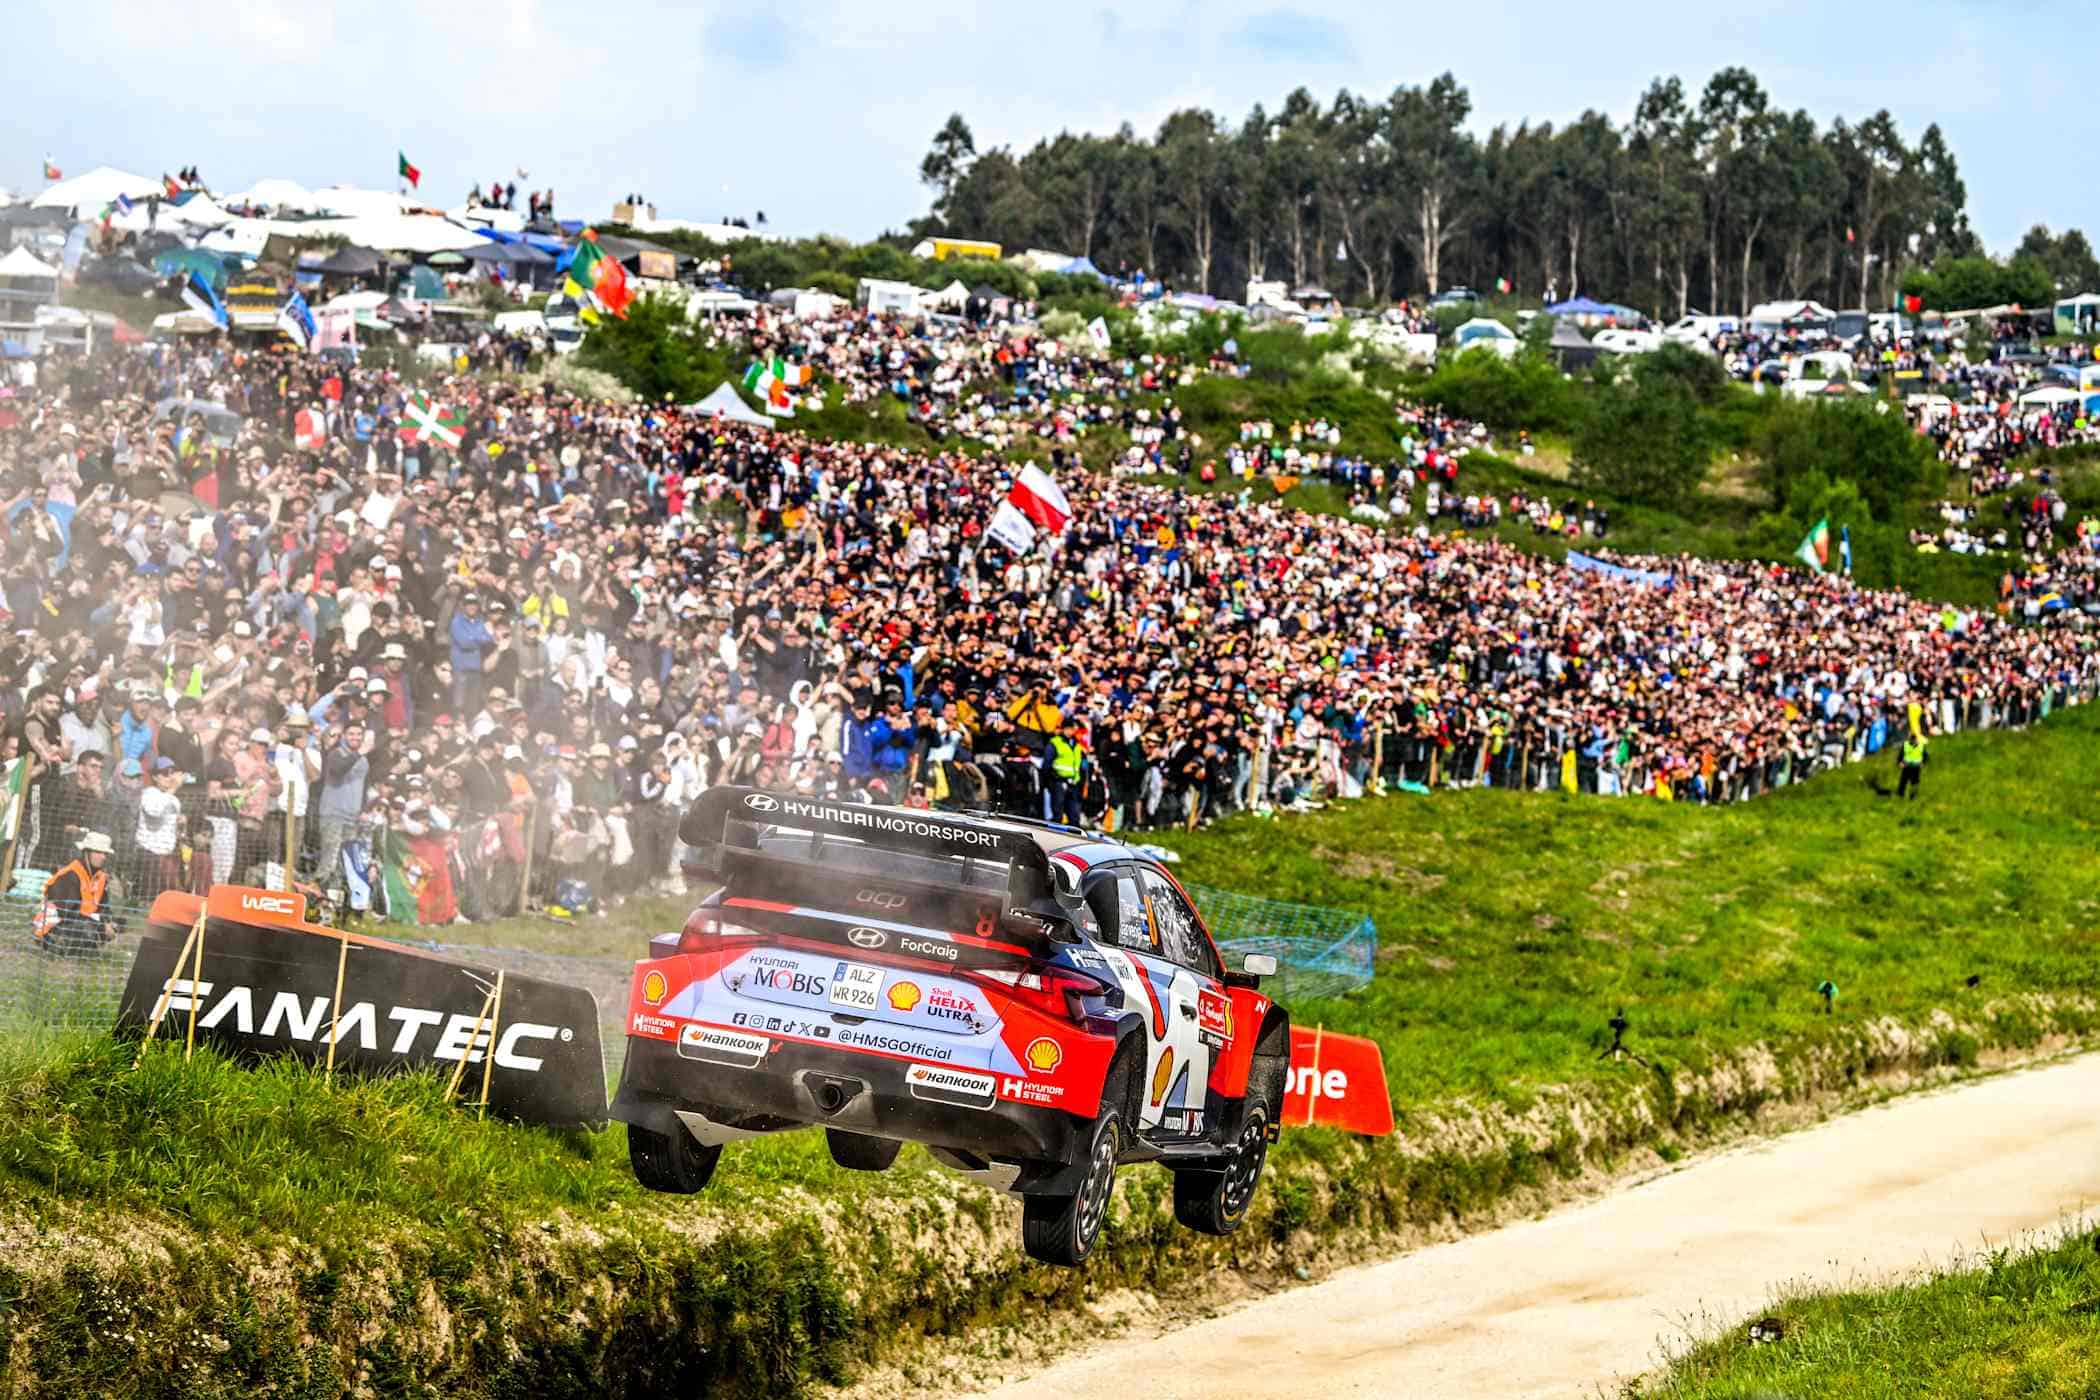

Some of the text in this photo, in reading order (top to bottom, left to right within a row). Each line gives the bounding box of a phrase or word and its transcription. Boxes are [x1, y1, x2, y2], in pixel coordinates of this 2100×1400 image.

[784, 800, 1001, 848] HYUNDAI MOTORSPORT
[242, 894, 295, 914] WRC
[900, 937, 959, 961] ForCraig
[750, 955, 799, 970] HYUNDAI
[754, 967, 827, 996] MOBIS
[849, 968, 876, 984] ALZ
[833, 985, 875, 1006] WR 926
[929, 994, 977, 1012] HELIX
[927, 1005, 974, 1023] ULTRA
[838, 1029, 953, 1061] @HMSGOfficial
[1023, 1081, 1065, 1096] HYUNDAI
[1023, 1091, 1053, 1104] STEEL
